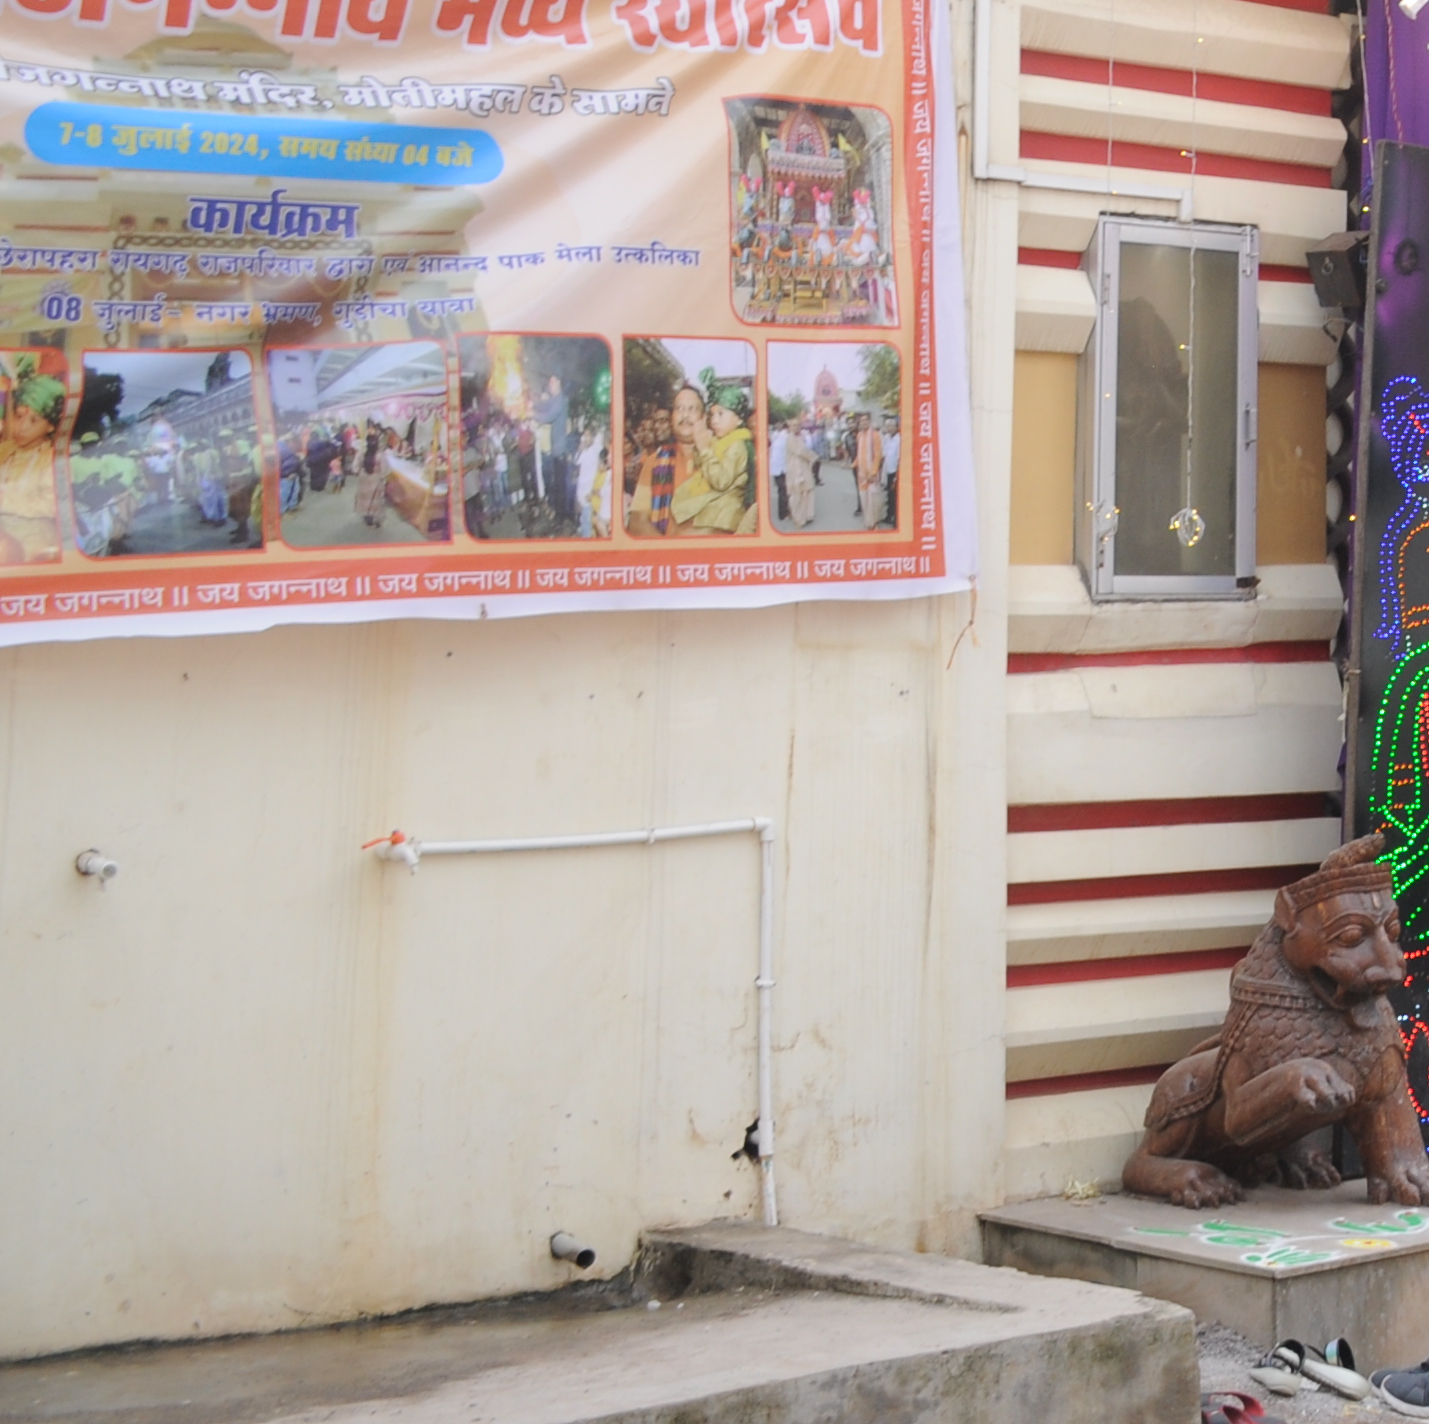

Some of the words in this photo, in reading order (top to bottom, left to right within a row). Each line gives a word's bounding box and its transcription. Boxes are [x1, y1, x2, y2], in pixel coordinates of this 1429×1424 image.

[212, 69, 335, 109] मंदिर,
[530, 75, 567, 117] के
[571, 77, 675, 117] सामने
[59, 121, 103, 147] 7-8
[111, 123, 192, 156] जुलाई
[279, 134, 341, 160] समय
[344, 135, 400, 164] संध्या
[402, 143, 429, 166] 04
[436, 140, 475, 168] बजे
[188, 189, 360, 239] कार्यक्रम
[418, 254, 489, 274] आनन्द
[498, 250, 546, 269] पाक
[554, 242, 603, 263] मेला
[612, 239, 702, 269] उत्कलिका
[44, 294, 83, 323] 08
[194, 301, 254, 323] नगर
[416, 297, 476, 318] यात्रा
[1, 593, 48, 617] जय
[55, 586, 165, 613] जगन्नाथ
[197, 582, 241, 605] जय
[247, 576, 348, 602] जगन्नाथ
[378, 573, 418, 594] जय
[424, 569, 512, 593] जगन्नाथ
[536, 567, 569, 588] जय
[573, 565, 653, 586] जगन्नाथ
[676, 563, 710, 583] जय
[714, 560, 791, 582] जगन्नाथ
[814, 559, 845, 580] जय
[850, 556, 917, 578] जगन्नाथ
